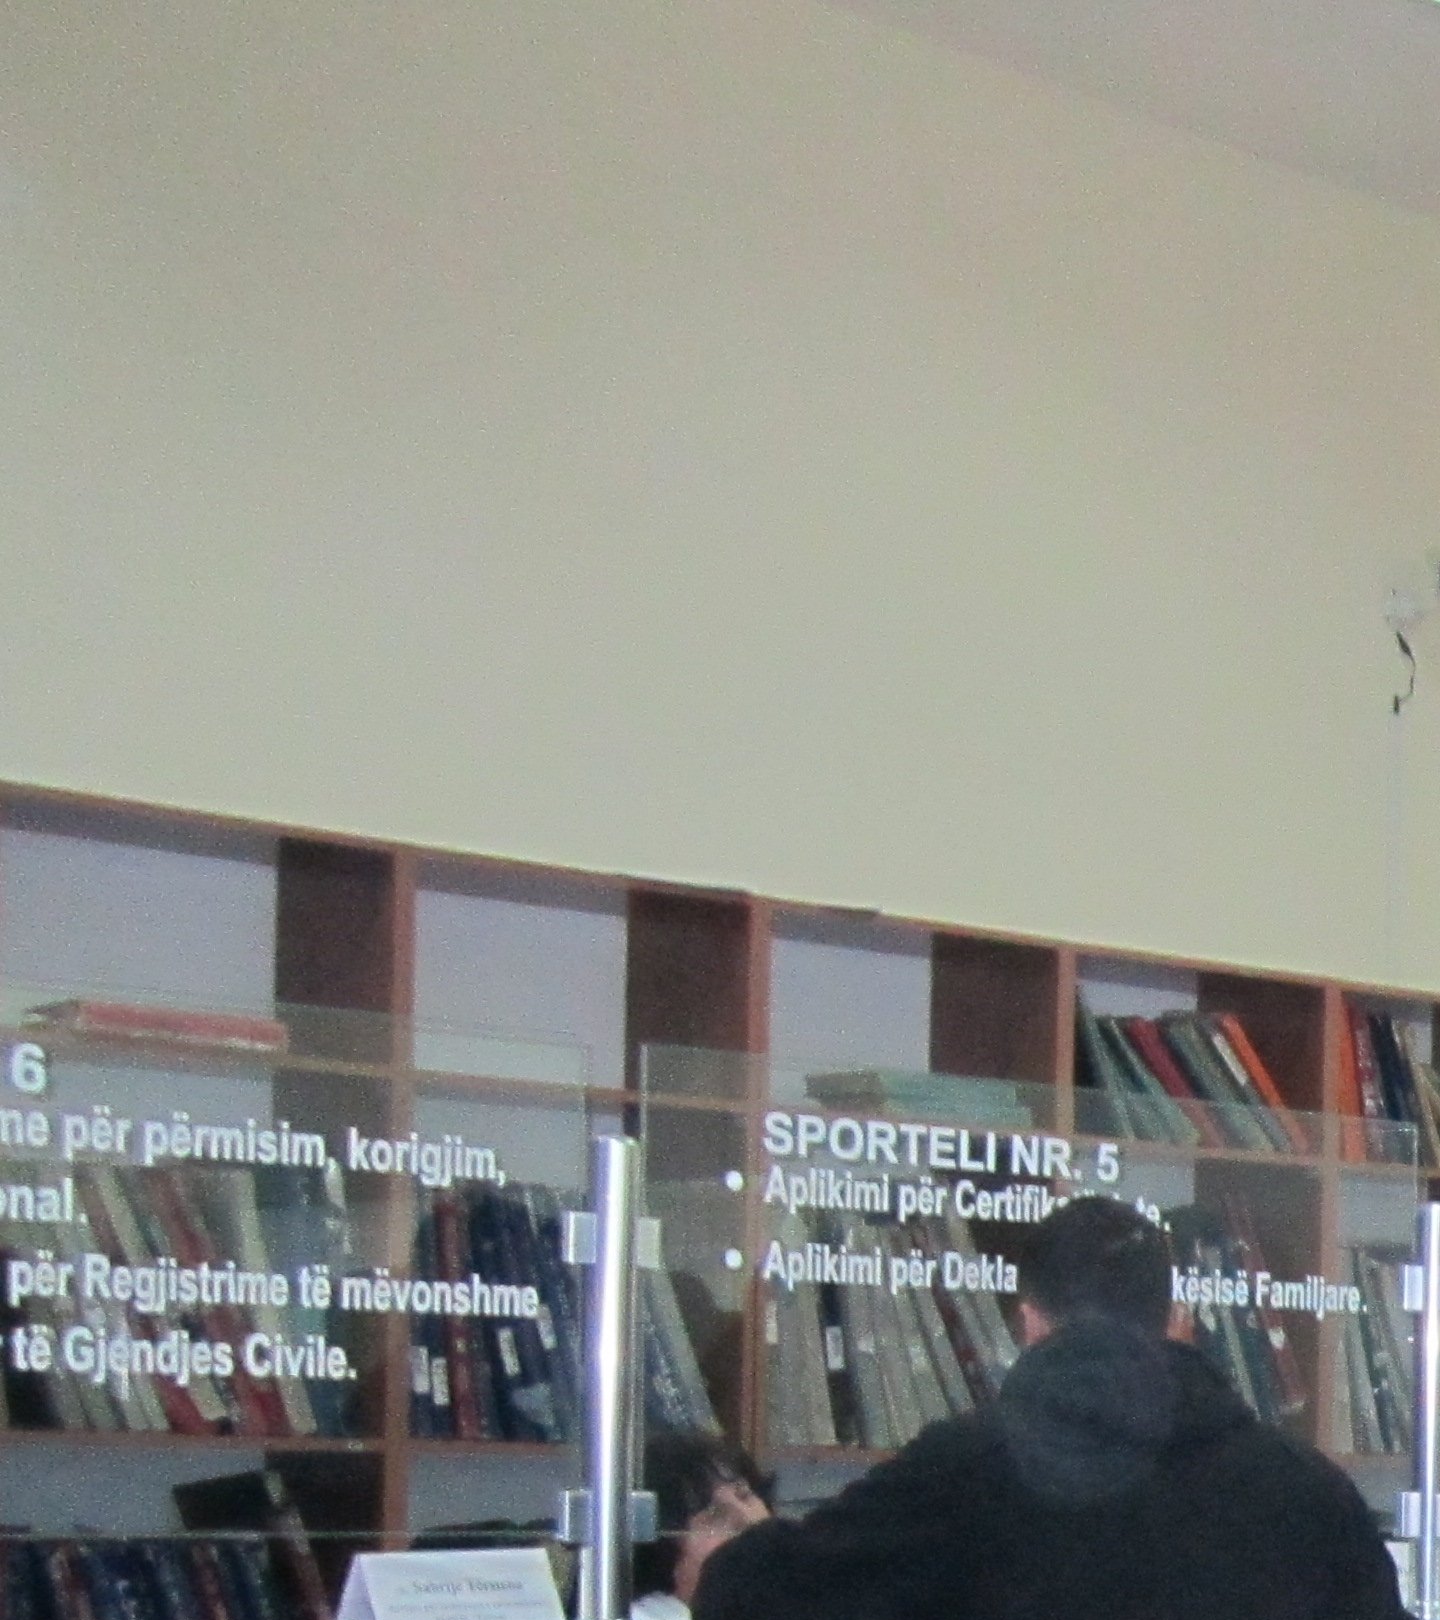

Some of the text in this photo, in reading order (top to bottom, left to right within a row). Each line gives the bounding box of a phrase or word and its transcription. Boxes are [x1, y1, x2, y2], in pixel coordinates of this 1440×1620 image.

[11, 1042, 46, 1093] 6
[62, 1105, 133, 1161] për
[144, 1111, 338, 1172] përmisim,
[347, 1126, 506, 1188] korigjim,
[762, 1111, 1119, 1182] SPORTELI NR. 5
[763, 1164, 890, 1215] Aplikimi
[896, 1175, 948, 1224] për
[7, 1249, 540, 1318] për Regjistrime të mëvonshme
[762, 1240, 1369, 1321] Aplikimi për Dekla kësisë Familjare.
[12, 1323, 357, 1386] të Gjendjes Civile.
